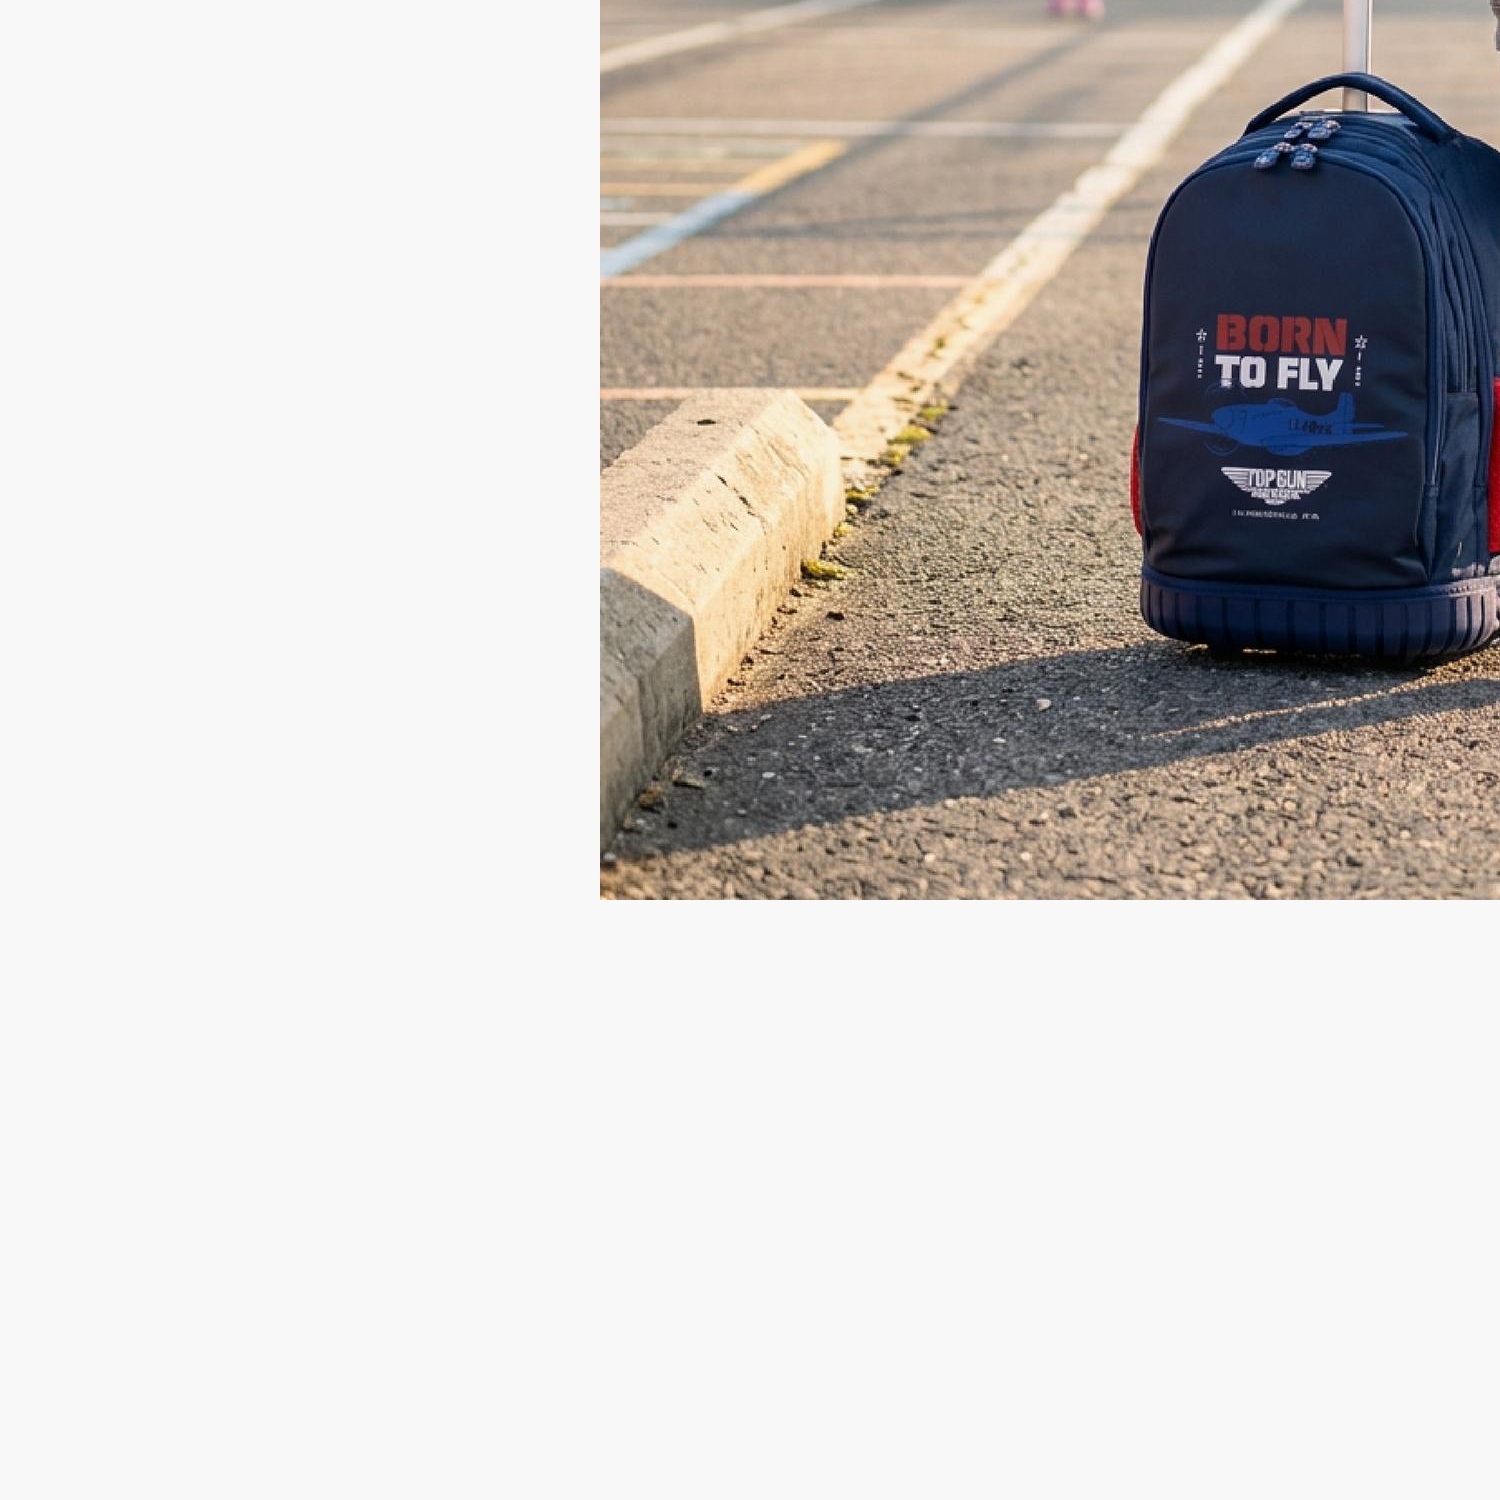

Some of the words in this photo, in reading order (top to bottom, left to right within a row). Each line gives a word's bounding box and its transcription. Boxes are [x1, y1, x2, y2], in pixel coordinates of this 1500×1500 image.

[1216, 313, 1348, 356] BORN
[1214, 354, 1267, 389] TO
[1276, 356, 1344, 391] FLY
[1249, 469, 1276, 487] TOP
[1277, 469, 1307, 489] GUN
